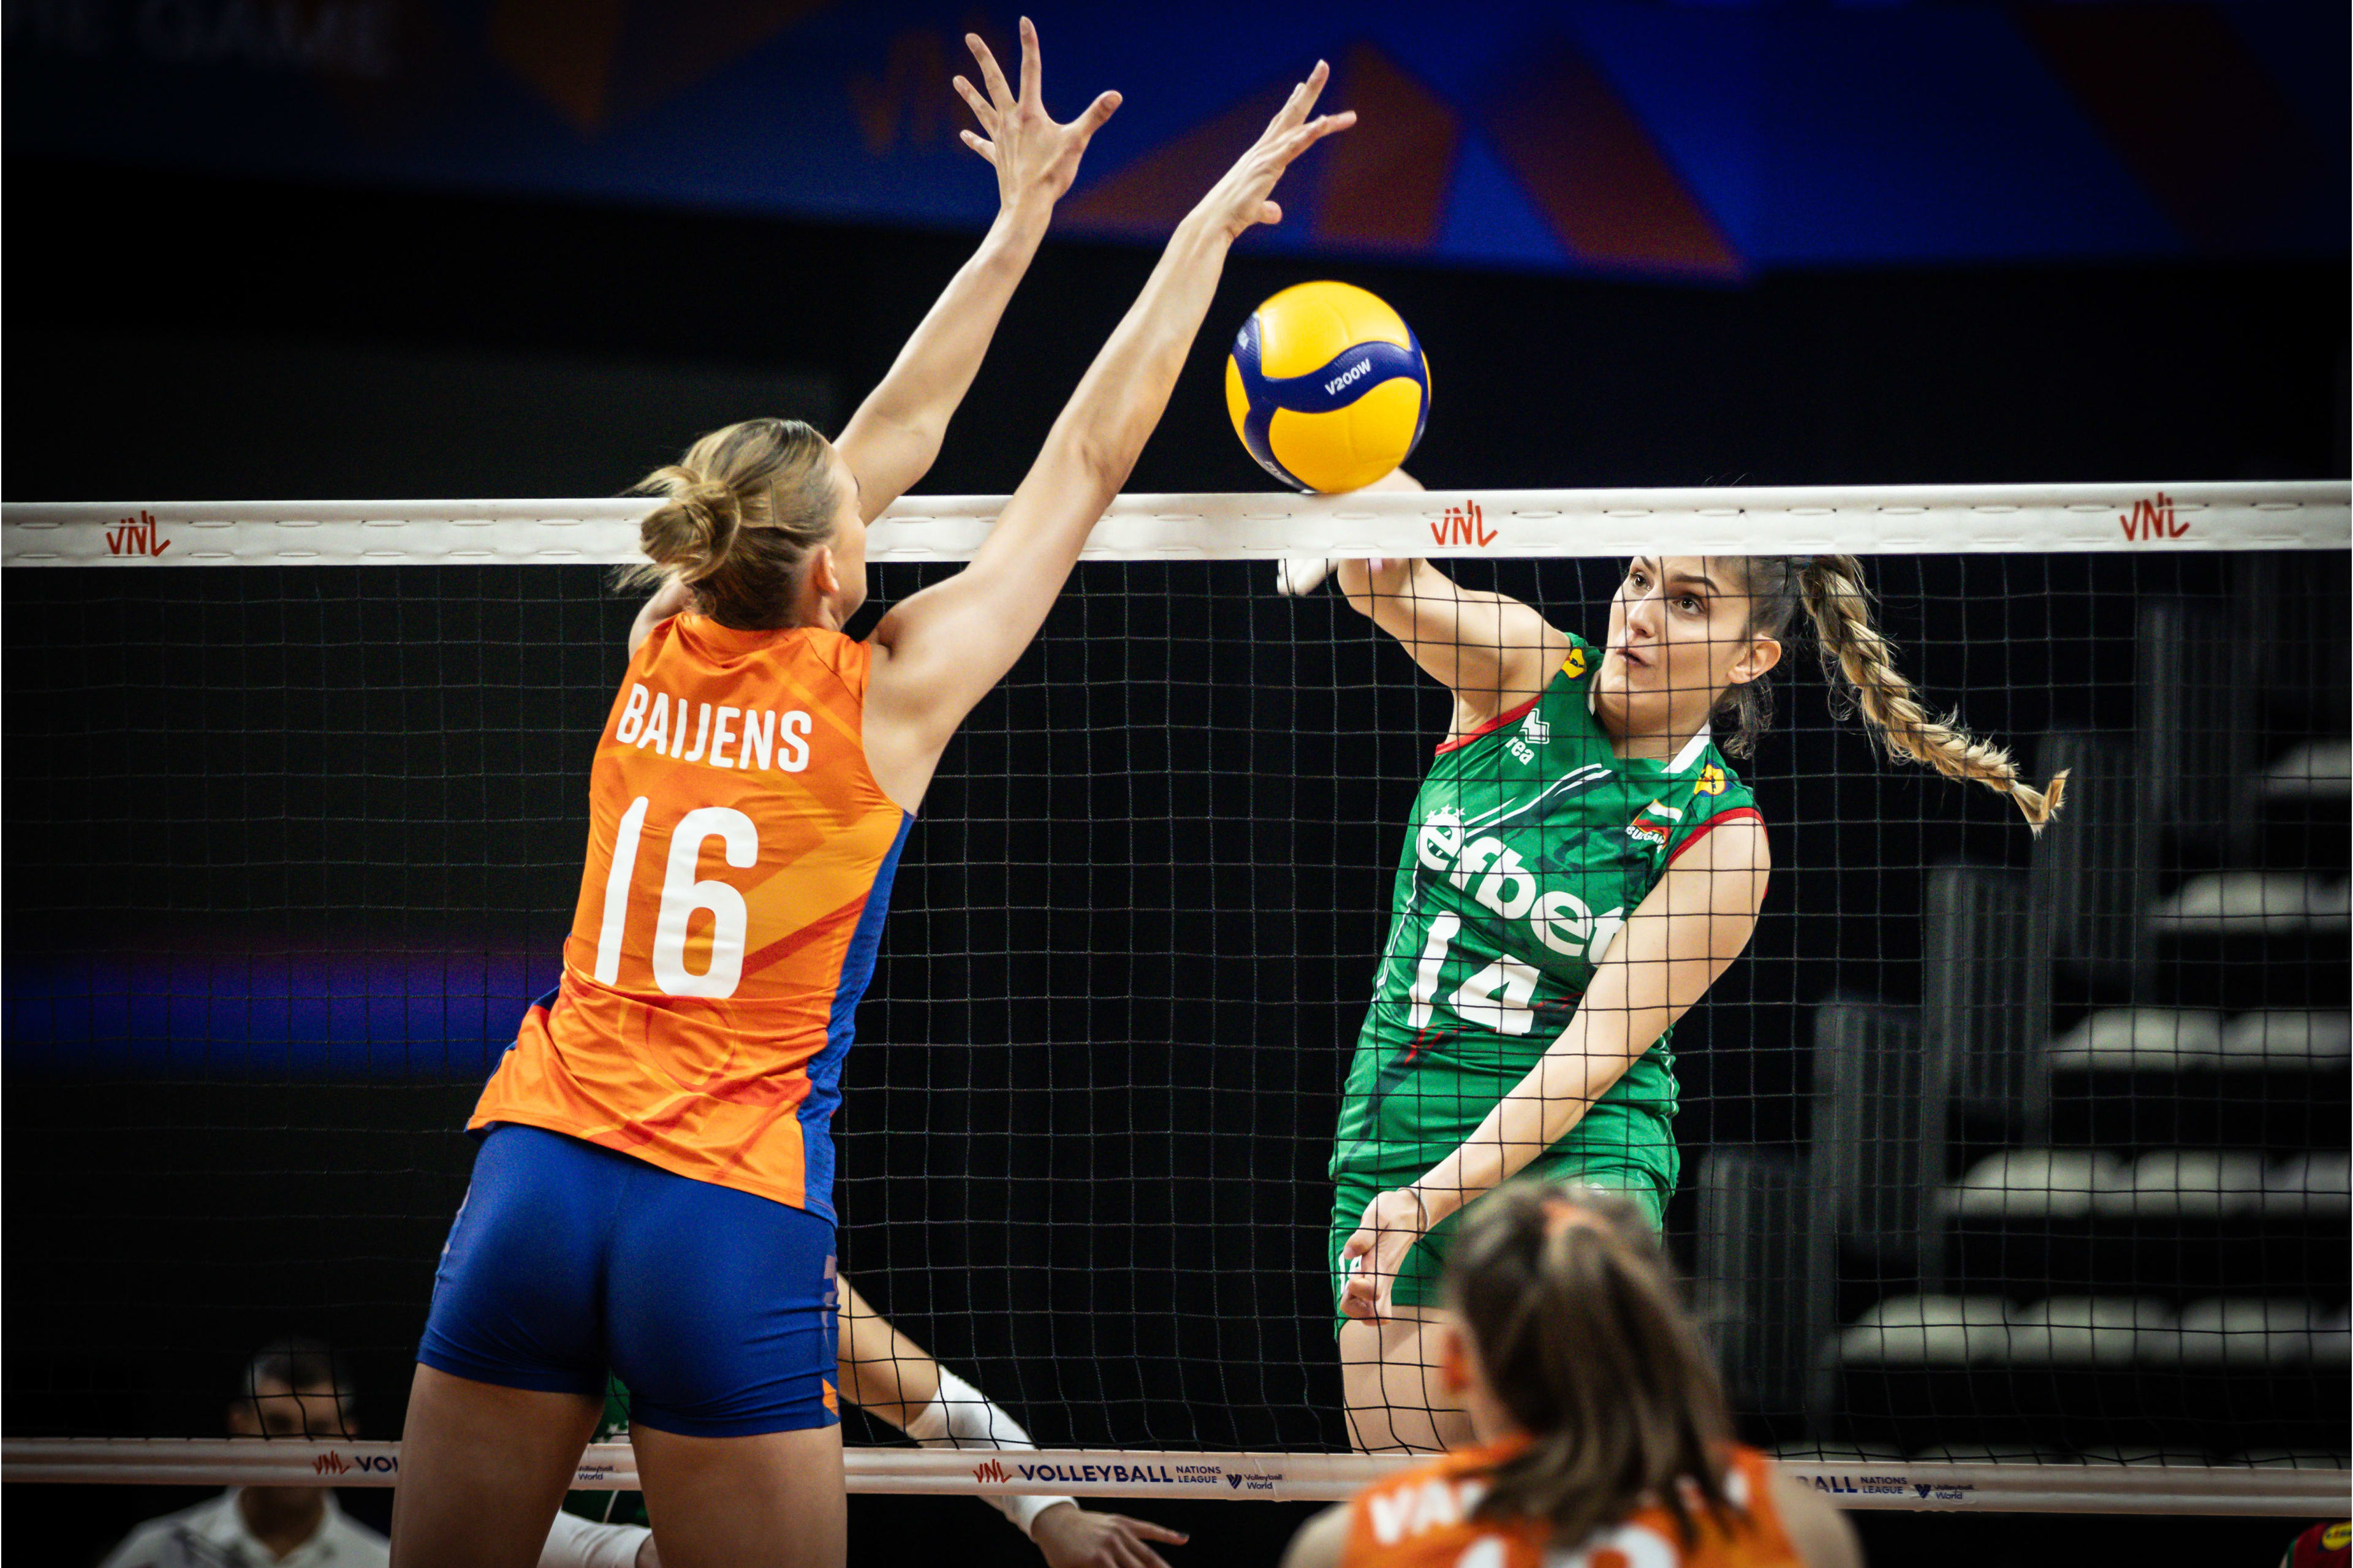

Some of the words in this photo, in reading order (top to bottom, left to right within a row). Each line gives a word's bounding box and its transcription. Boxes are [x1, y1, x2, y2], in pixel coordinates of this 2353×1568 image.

[1325, 359, 1371, 395] V200W
[1430, 499, 1498, 548] VNL
[2119, 492, 2190, 541] VNL
[105, 510, 171, 557] VNL
[616, 683, 812, 772] BAIJENS
[594, 796, 759, 998] 16
[1408, 910, 1540, 1036] 14
[312, 1450, 350, 1475] VNL
[972, 1458, 1012, 1483] VNL
[1018, 1464, 1173, 1483] VOLLEYBALL
[1176, 1466, 1222, 1474] NATIONS
[1860, 1476, 1908, 1485] NATIONS
[1862, 1485, 1903, 1494] LEAGUE
[1936, 1491, 1963, 1500] World
